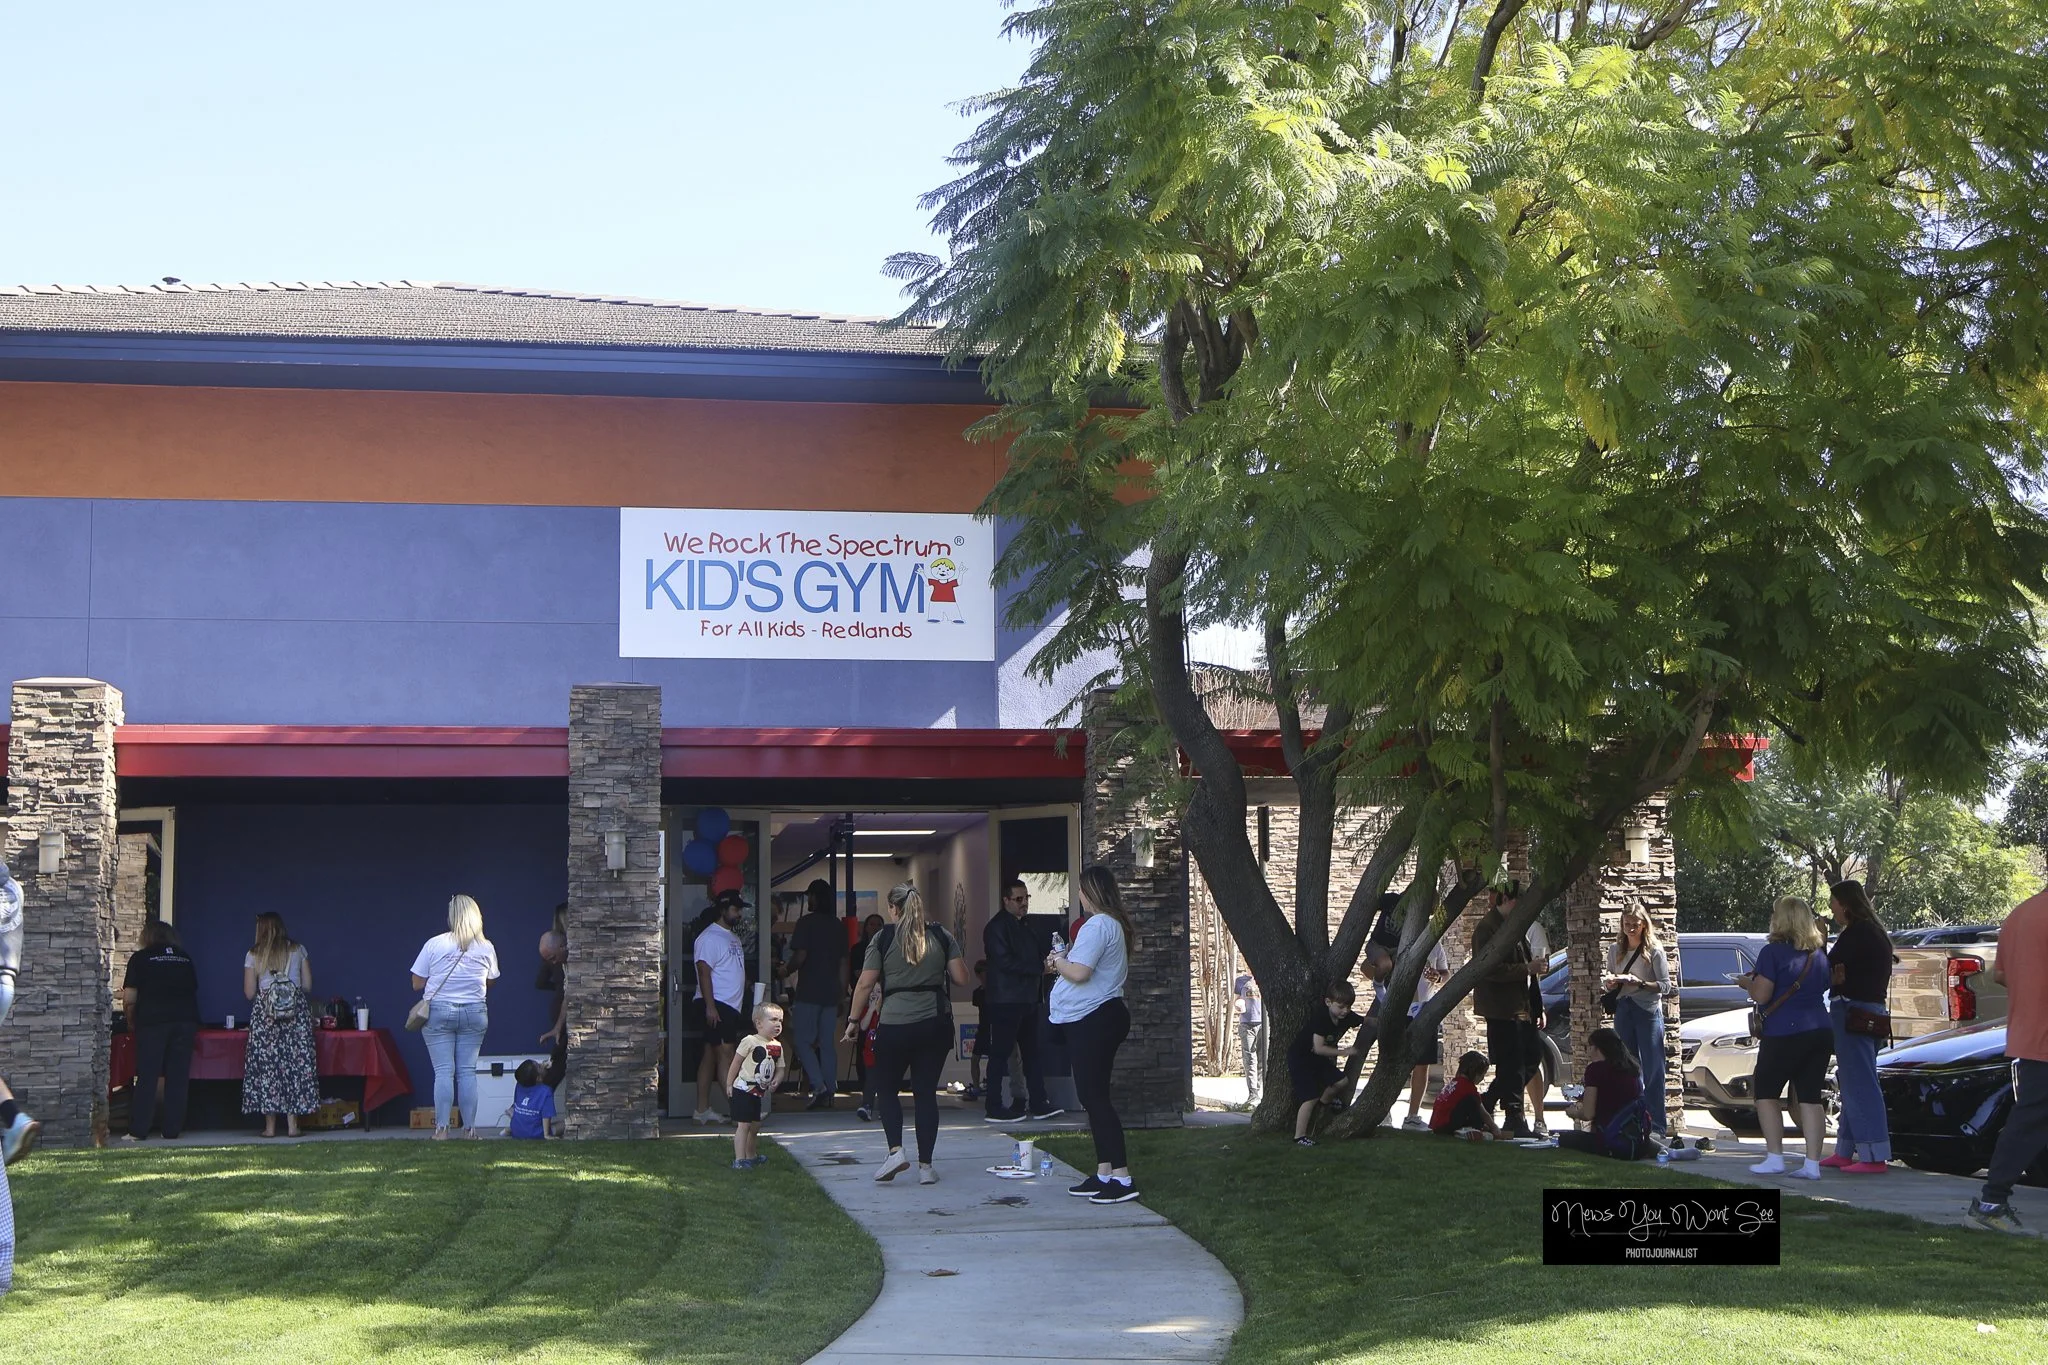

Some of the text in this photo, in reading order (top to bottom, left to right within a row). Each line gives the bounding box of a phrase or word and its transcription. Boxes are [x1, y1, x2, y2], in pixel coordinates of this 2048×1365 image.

[664, 532, 704, 554] We
[708, 532, 771, 554] Rock
[776, 531, 822, 556] The
[826, 533, 952, 561] Spectrum
[645, 558, 925, 614] KID'S GYM
[700, 619, 733, 637] For
[738, 620, 764, 637] All
[768, 620, 806, 638] Kids
[822, 620, 913, 639] Redlands
